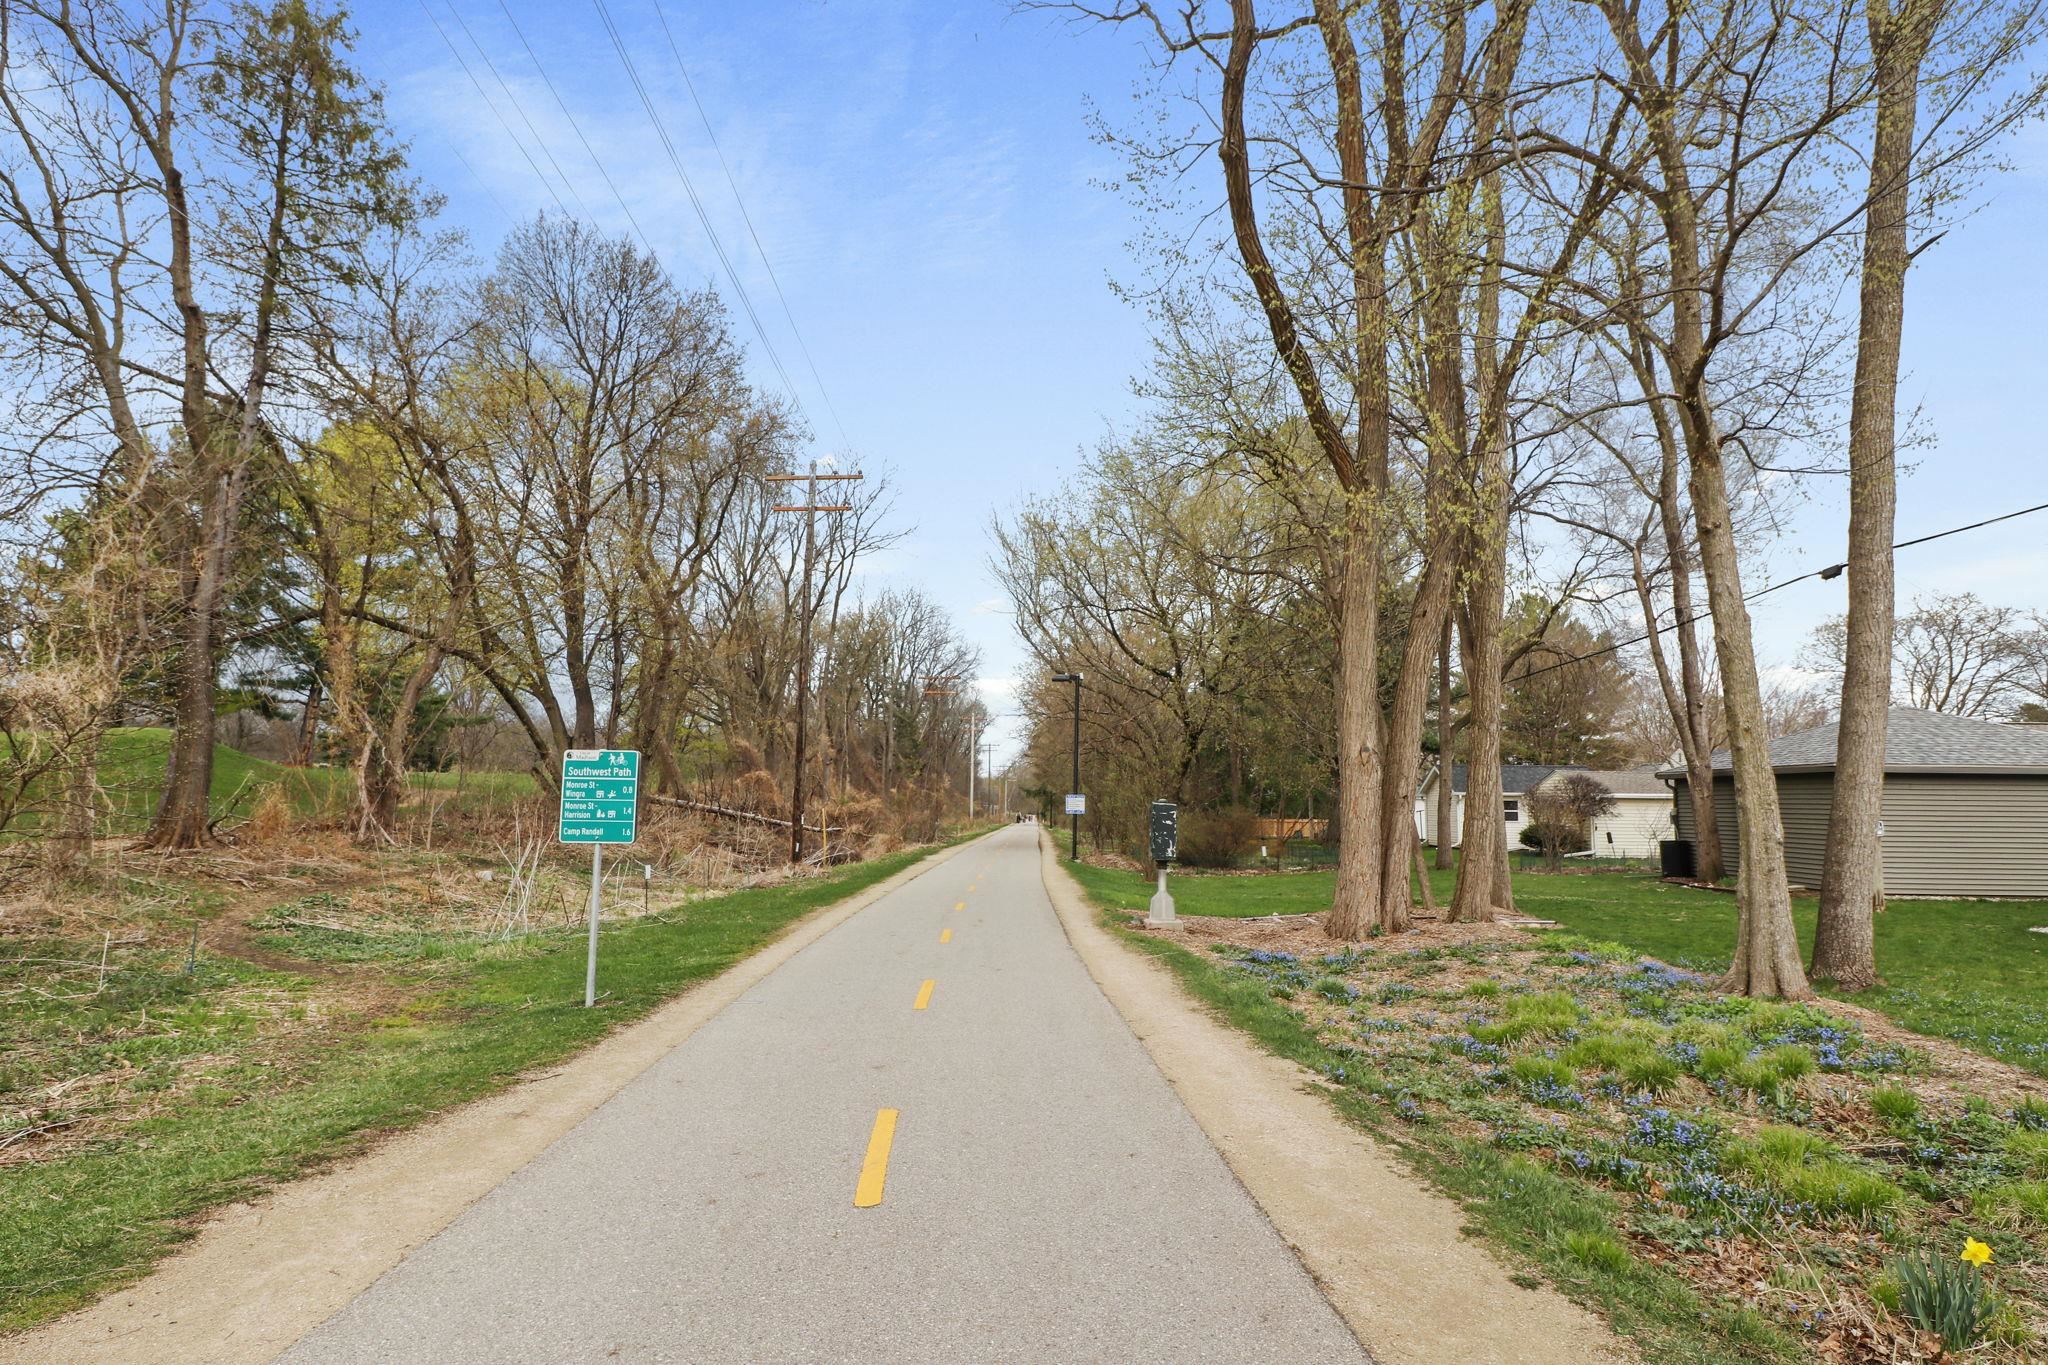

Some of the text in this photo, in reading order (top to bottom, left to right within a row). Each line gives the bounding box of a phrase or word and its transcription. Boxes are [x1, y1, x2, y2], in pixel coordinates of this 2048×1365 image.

[568, 767, 631, 776] Southwest Path
[566, 790, 585, 799] Wingra
